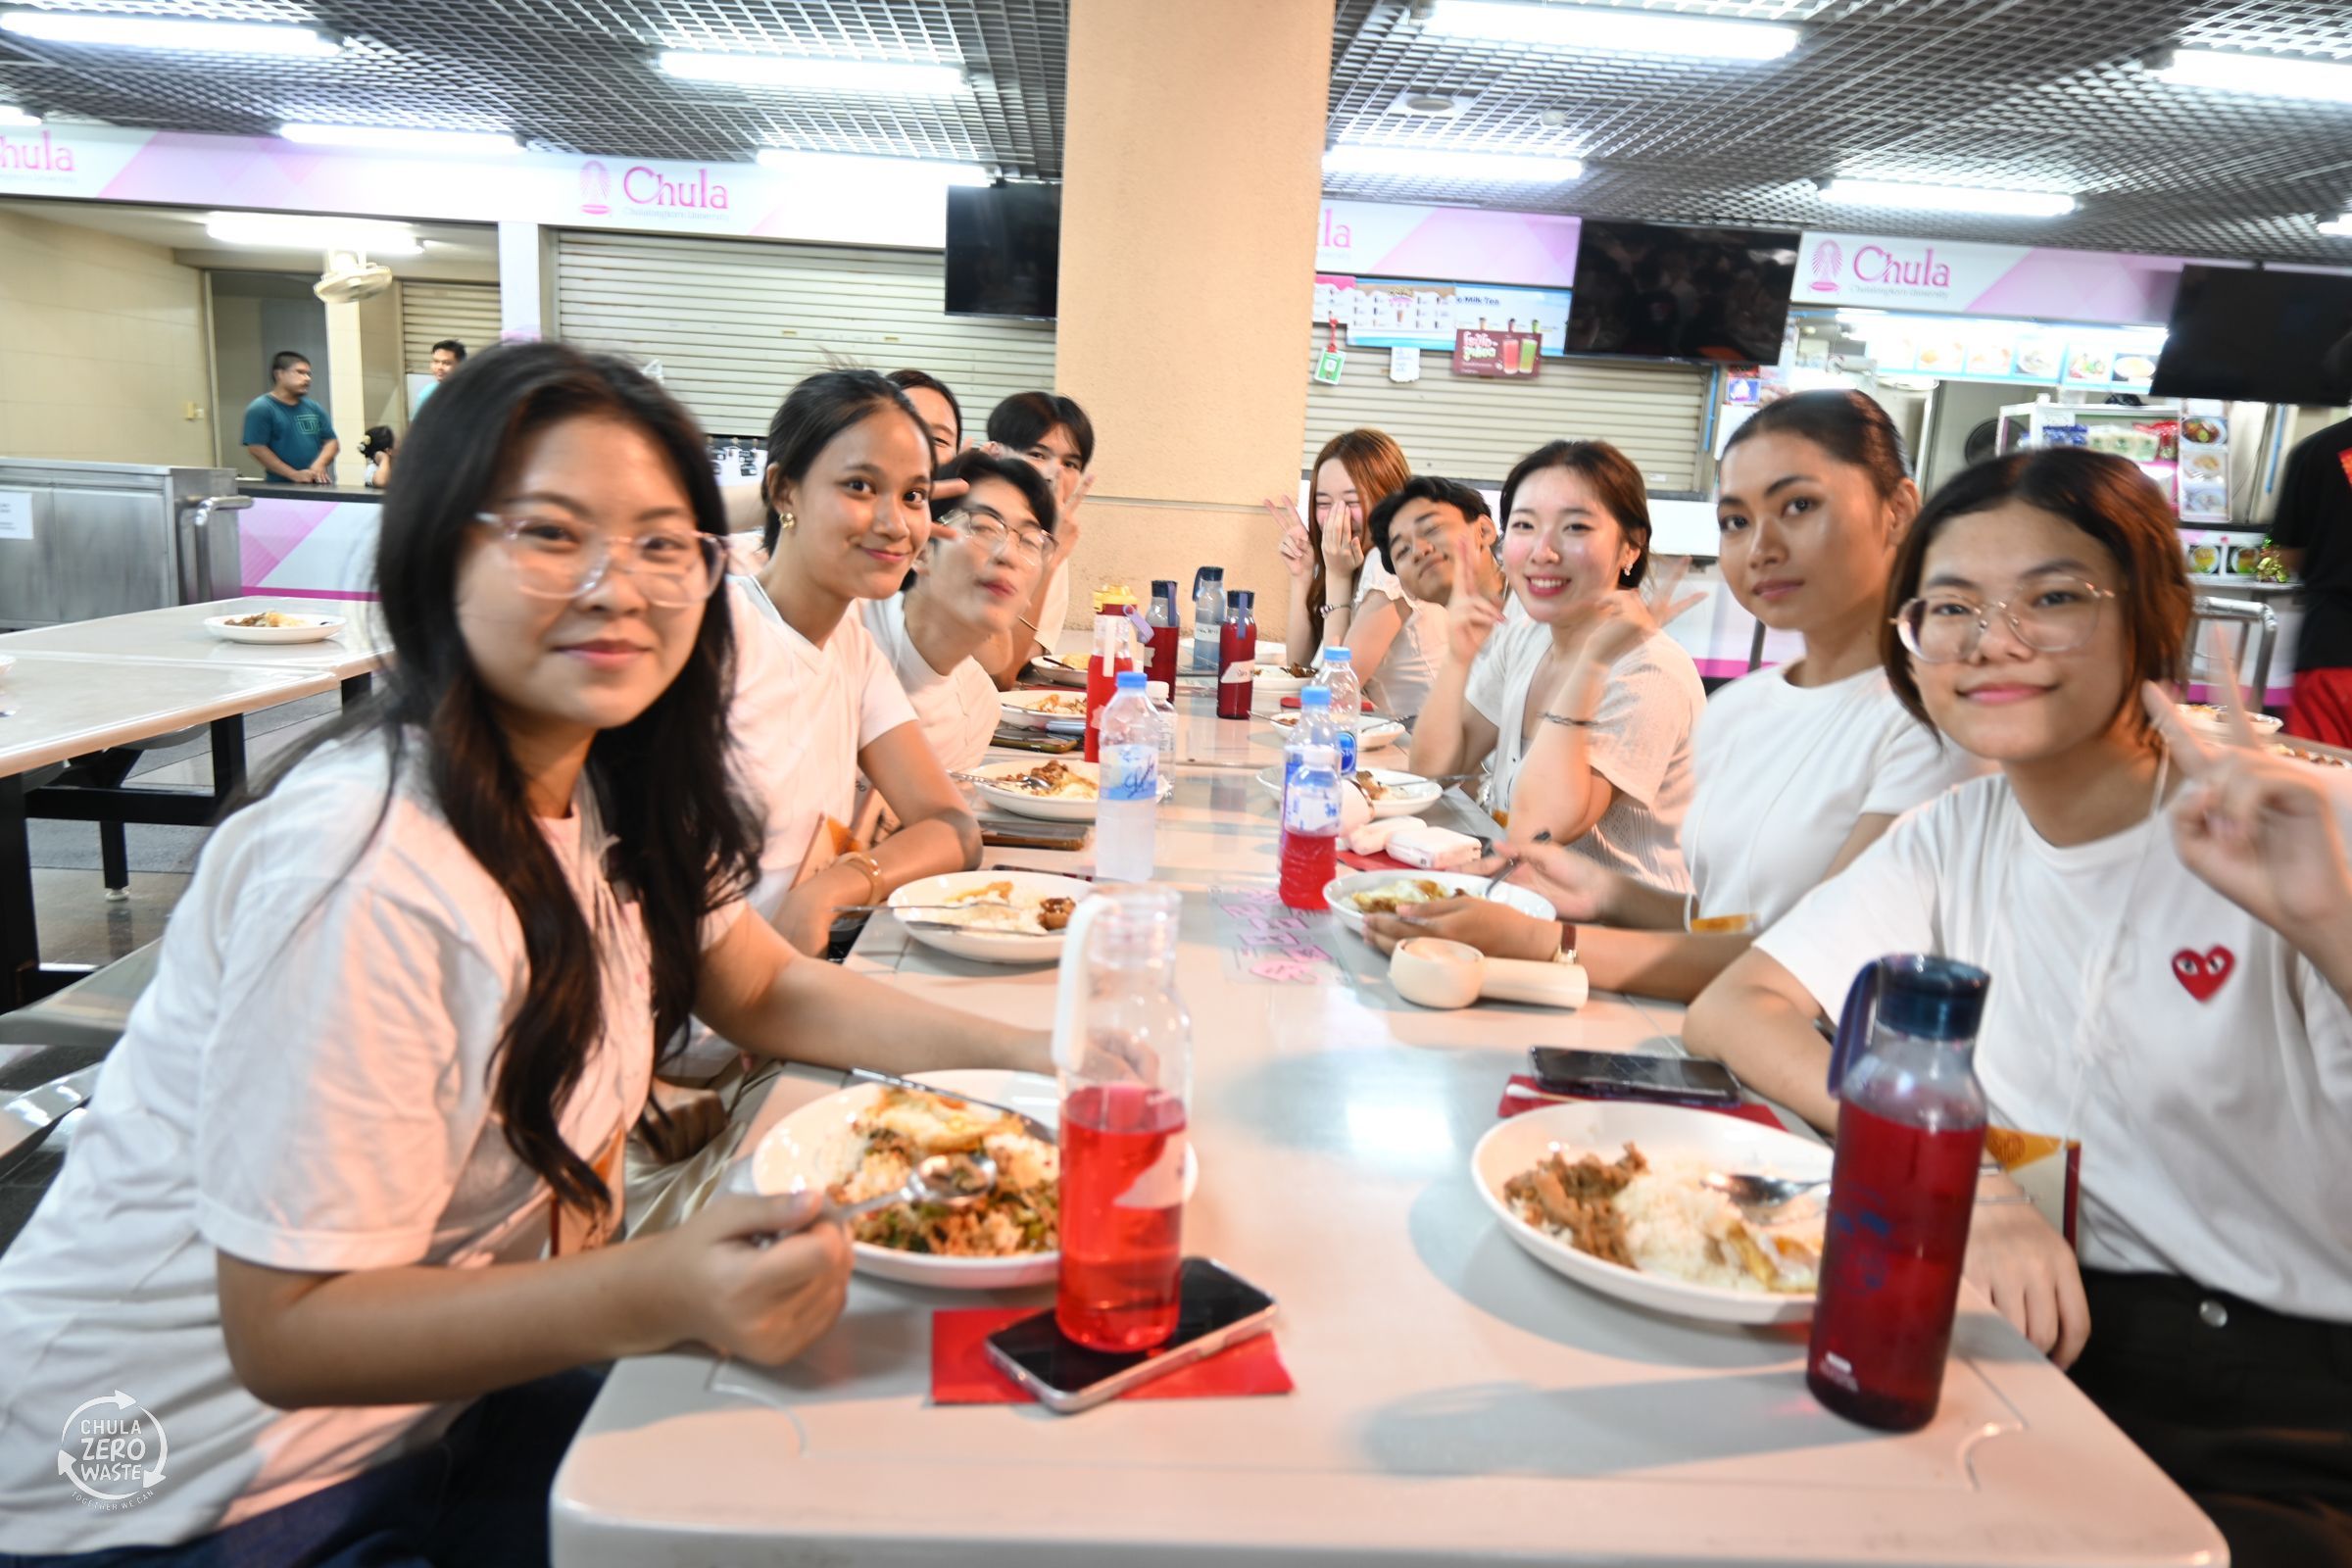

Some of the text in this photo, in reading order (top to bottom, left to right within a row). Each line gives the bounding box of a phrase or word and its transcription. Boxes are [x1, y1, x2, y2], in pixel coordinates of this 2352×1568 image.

[0, 129, 77, 171] hula
[623, 166, 729, 209] Chula
[1853, 245, 1951, 287] Chula
